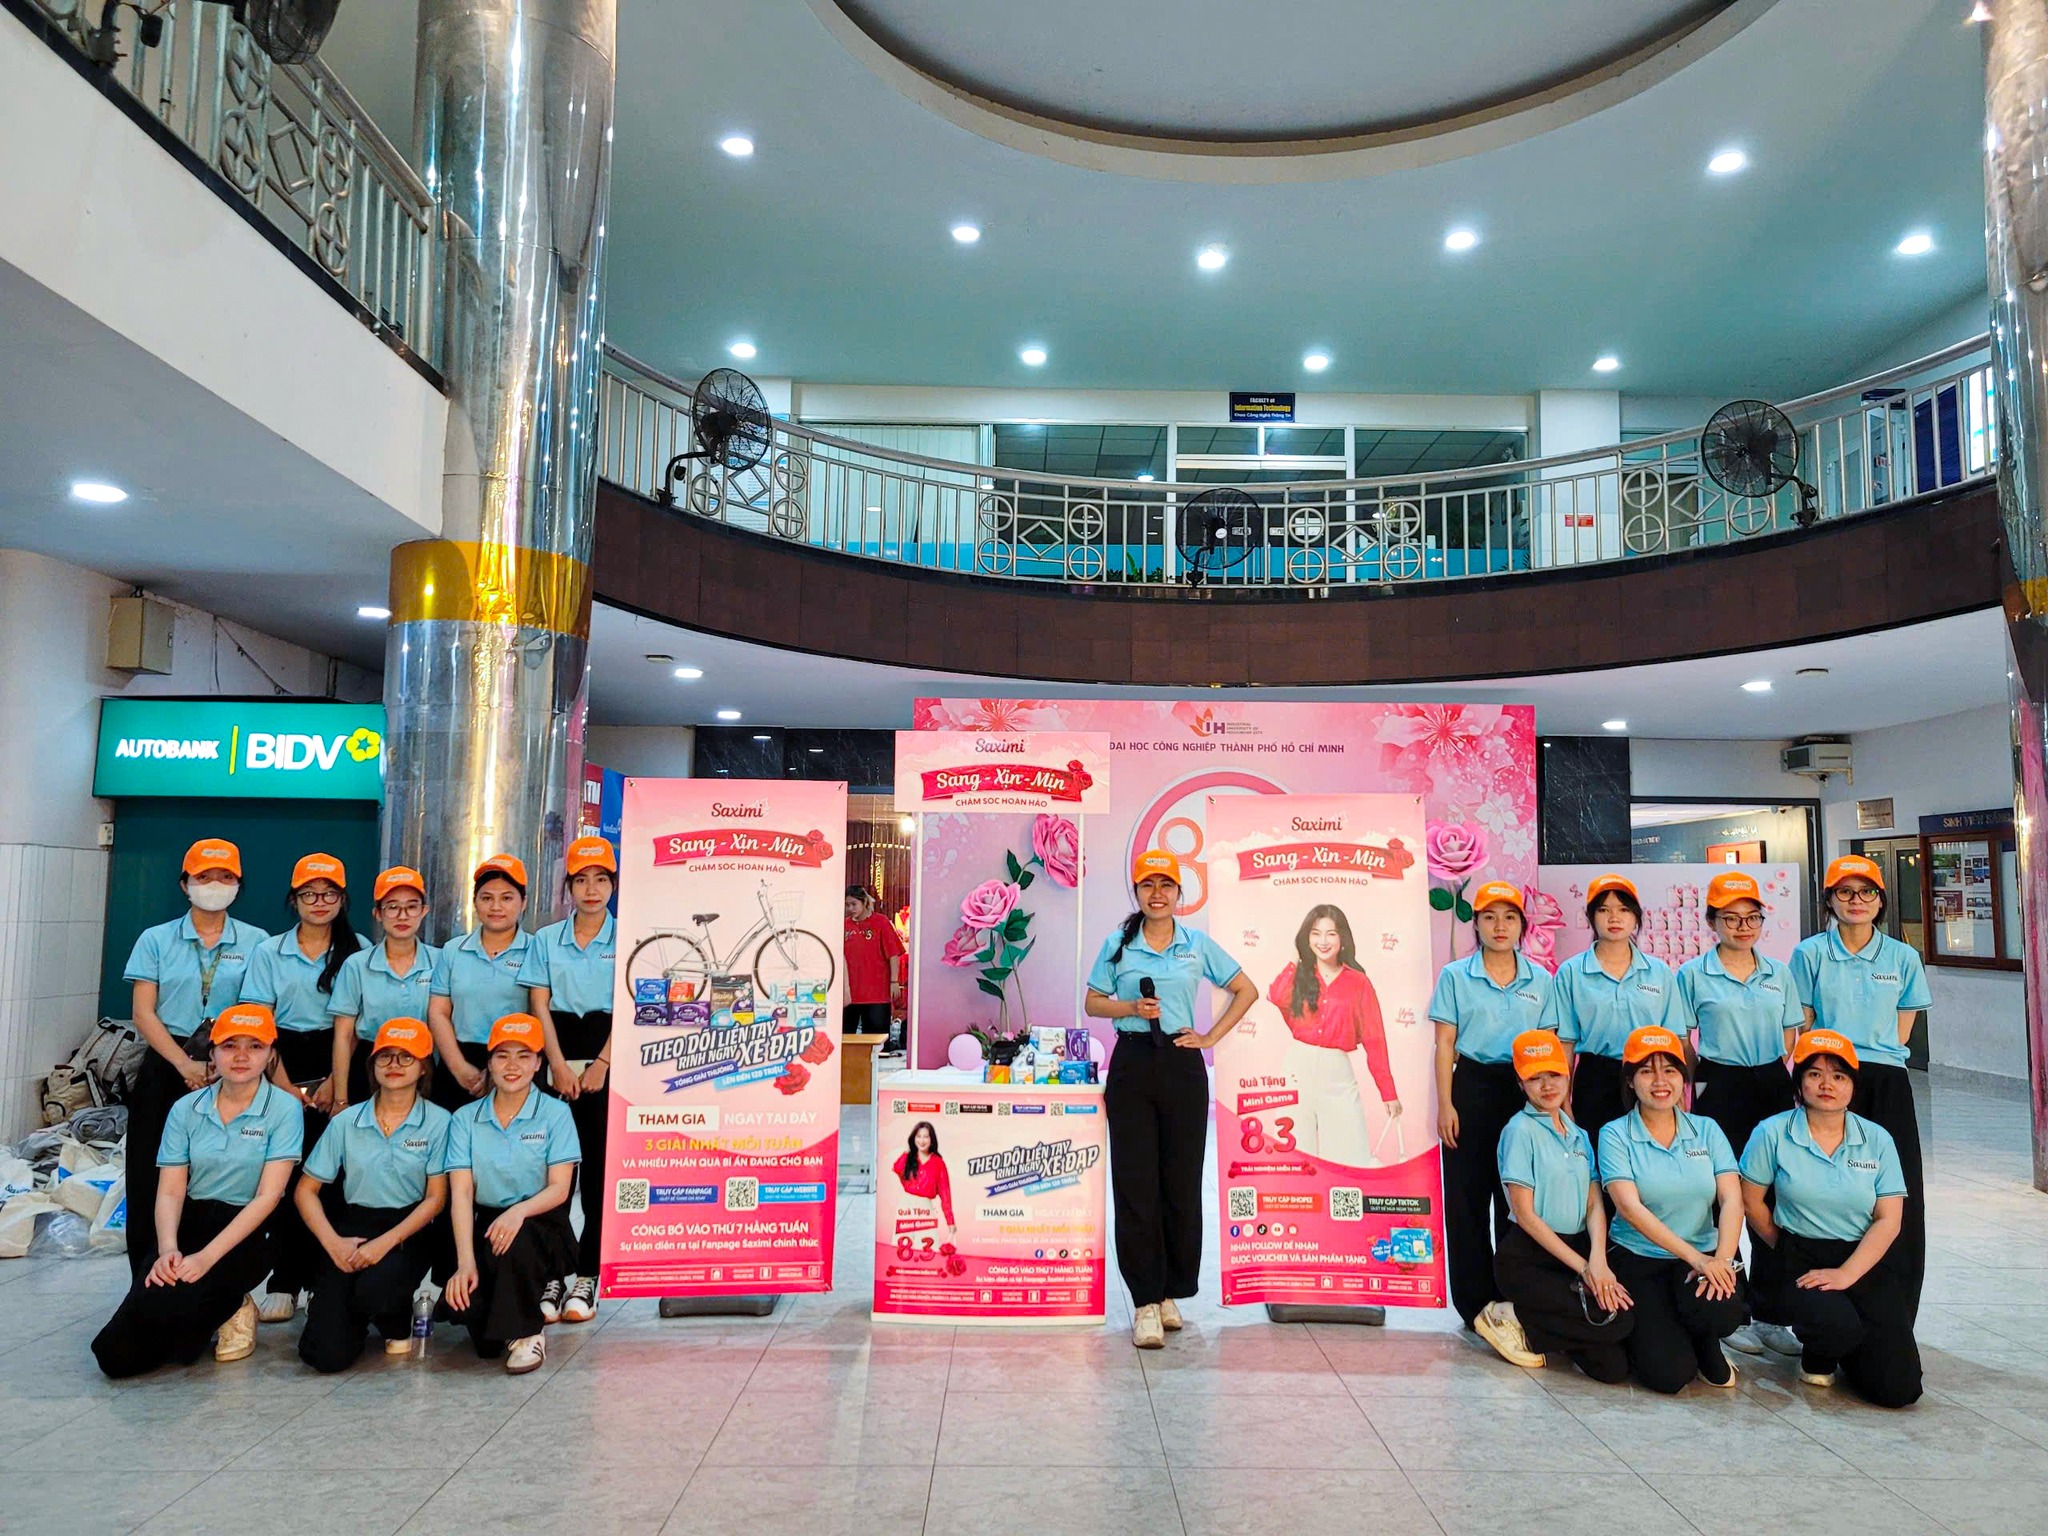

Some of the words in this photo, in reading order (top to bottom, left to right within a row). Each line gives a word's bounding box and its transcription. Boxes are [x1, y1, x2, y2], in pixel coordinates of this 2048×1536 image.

[1264, 404, 1291, 412] Technology
[115, 738, 220, 760] AUTOBANK
[246, 733, 348, 770] BIDV
[975, 738, 1026, 753] Saximi
[1130, 741, 1150, 753] HỌC
[1153, 740, 1179, 751] CÔNG
[1182, 740, 1216, 753] NGHIỆP
[1220, 741, 1254, 752] THÀNH
[1258, 740, 1278, 753] PHỐ
[1299, 742, 1314, 753] CHÍ
[1318, 744, 1344, 754] MINH
[936, 772, 982, 790] Sang
[994, 768, 1022, 788] Xịn
[1031, 772, 1066, 791] Mịn
[711, 802, 763, 818] Saximi
[1291, 816, 1342, 831] Saximi
[670, 838, 717, 857] Sang
[730, 833, 758, 854] Xịn
[768, 836, 805, 858] Mịn
[1253, 852, 1299, 870] Sang
[1312, 846, 1340, 867] Xịn
[1350, 849, 1387, 870] Mịn
[642, 1038, 684, 1064] THEO
[687, 1029, 716, 1054] DÕI
[719, 1022, 749, 1048] LIỀN
[750, 1020, 776, 1041] TAY
[678, 1052, 706, 1070] RINH
[708, 1045, 738, 1065] NGAY
[738, 1038, 766, 1066] XE
[768, 1027, 814, 1062] ĐẠP
[1240, 1078, 1258, 1088] Quà
[1261, 1076, 1286, 1088] Tặng
[1243, 1098, 1263, 1107] Mini
[1265, 1094, 1293, 1104] Game
[639, 1114, 679, 1125] THAM
[682, 1113, 706, 1125] GIA
[724, 1112, 762, 1125] NGAY
[240, 1127, 264, 1137] Saximi
[519, 1132, 546, 1142] Saximi
[1241, 1116, 1296, 1154] 8.3
[645, 1140, 652, 1151] 3
[656, 1138, 686, 1151] GIẢI
[622, 1158, 636, 1168] VÀ
[698, 1156, 720, 1168] QUÀ
[723, 1156, 732, 1167] BÍ
[804, 1156, 823, 1167] BẠN
[968, 1154, 1001, 1175] THEO
[1003, 1146, 1025, 1167] DÕI
[1026, 1142, 1049, 1162] LIỀN
[1051, 1140, 1071, 1156] TAY
[996, 1166, 1017, 1179] RINH
[1019, 1161, 1041, 1173] NGAY
[1041, 1156, 1061, 1178] XE
[1064, 1146, 1099, 1174] ĐẠP
[1848, 1159, 1877, 1170] Saximi
[898, 1208, 911, 1216] Quà
[914, 1208, 930, 1216] Tặng
[983, 1209, 1007, 1217] THAM
[1009, 1209, 1024, 1217] GIA
[631, 1224, 666, 1236] CÔNG
[668, 1222, 684, 1236] BỐ
[686, 1224, 710, 1235] VÀO
[713, 1221, 736, 1234] THỨ
[737, 1224, 743, 1234] 7
[746, 1220, 777, 1234] HÀNG
[780, 1220, 809, 1233] TUẦN
[688, 1240, 700, 1250] tại
[702, 1240, 740, 1251] Fanpage
[742, 1238, 771, 1248] Saximi
[773, 1238, 797, 1247] chính
[799, 1238, 818, 1247] thức
[897, 1236, 935, 1262] 8.3
[1252, 1242, 1282, 1250] FOLLOW
[1295, 1242, 1318, 1251] NHẬN
[1252, 1254, 1288, 1263] VOUCHER
[1290, 1254, 1301, 1262] VÀ
